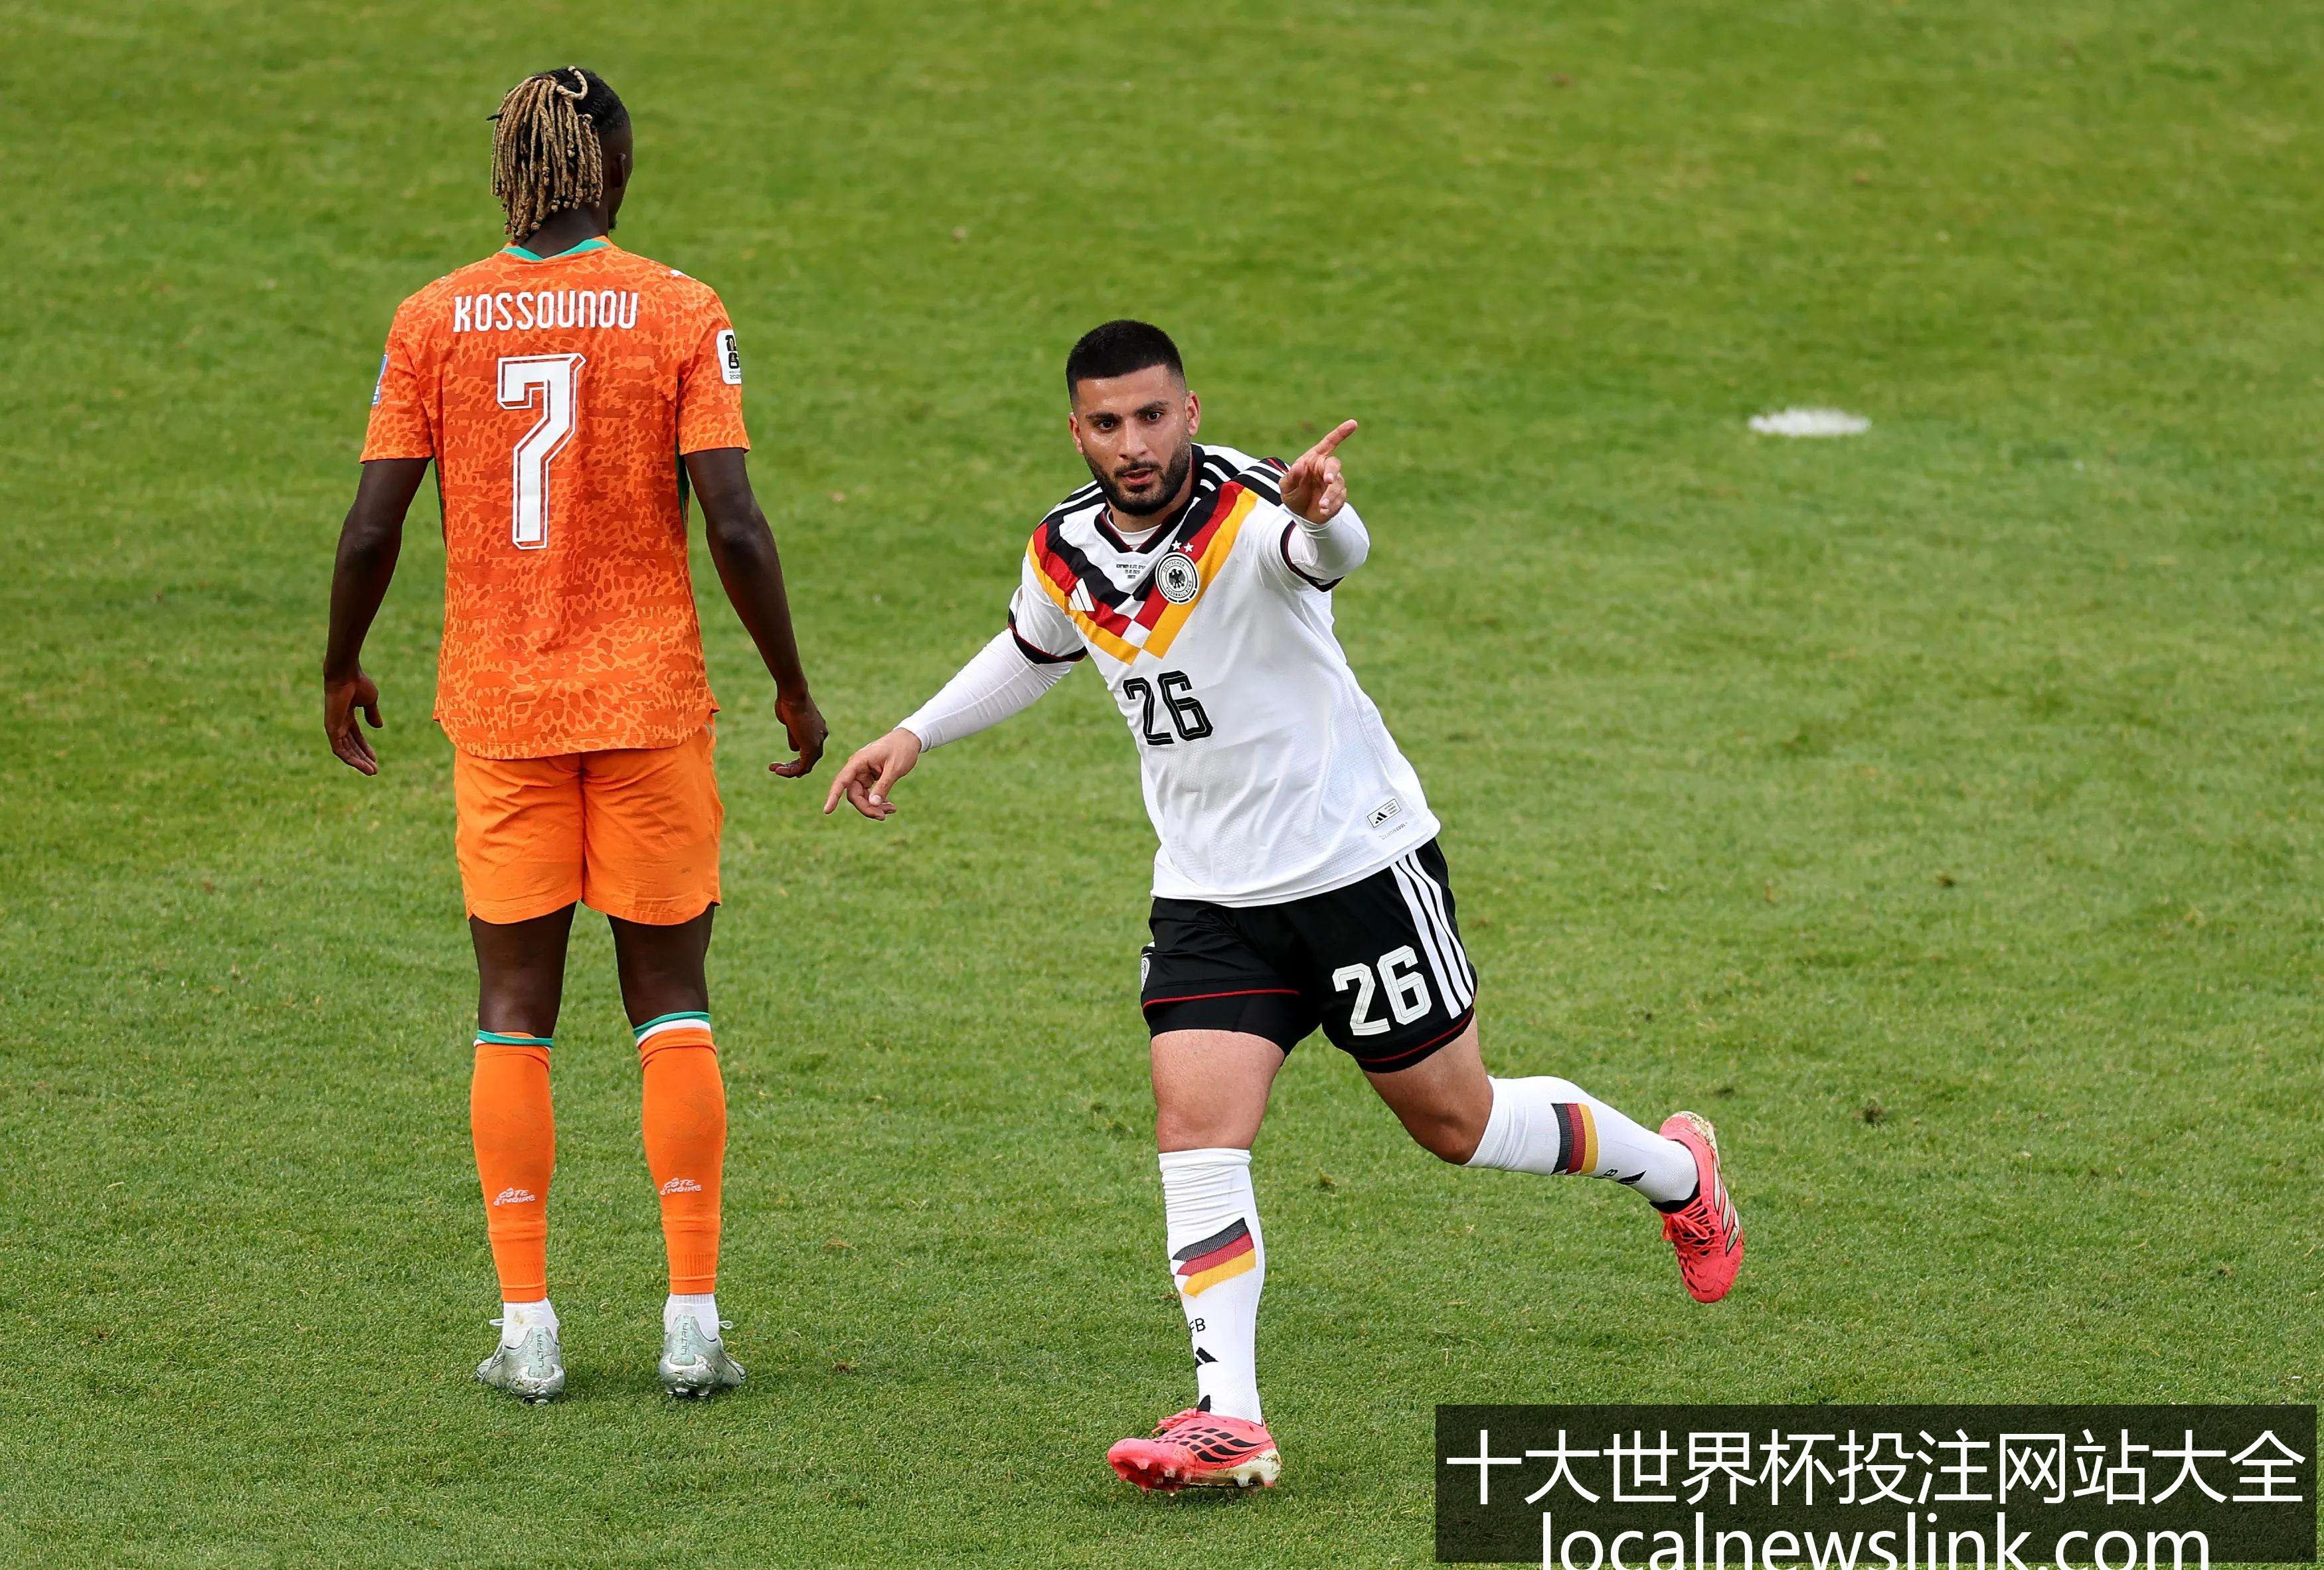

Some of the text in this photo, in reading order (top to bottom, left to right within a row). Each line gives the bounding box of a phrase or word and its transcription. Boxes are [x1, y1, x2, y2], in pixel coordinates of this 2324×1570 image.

[453, 289, 639, 333] KOSSOUNOU
[497, 353, 586, 550] 7
[1122, 670, 1214, 746] 26
[1331, 945, 1432, 1036] 26
